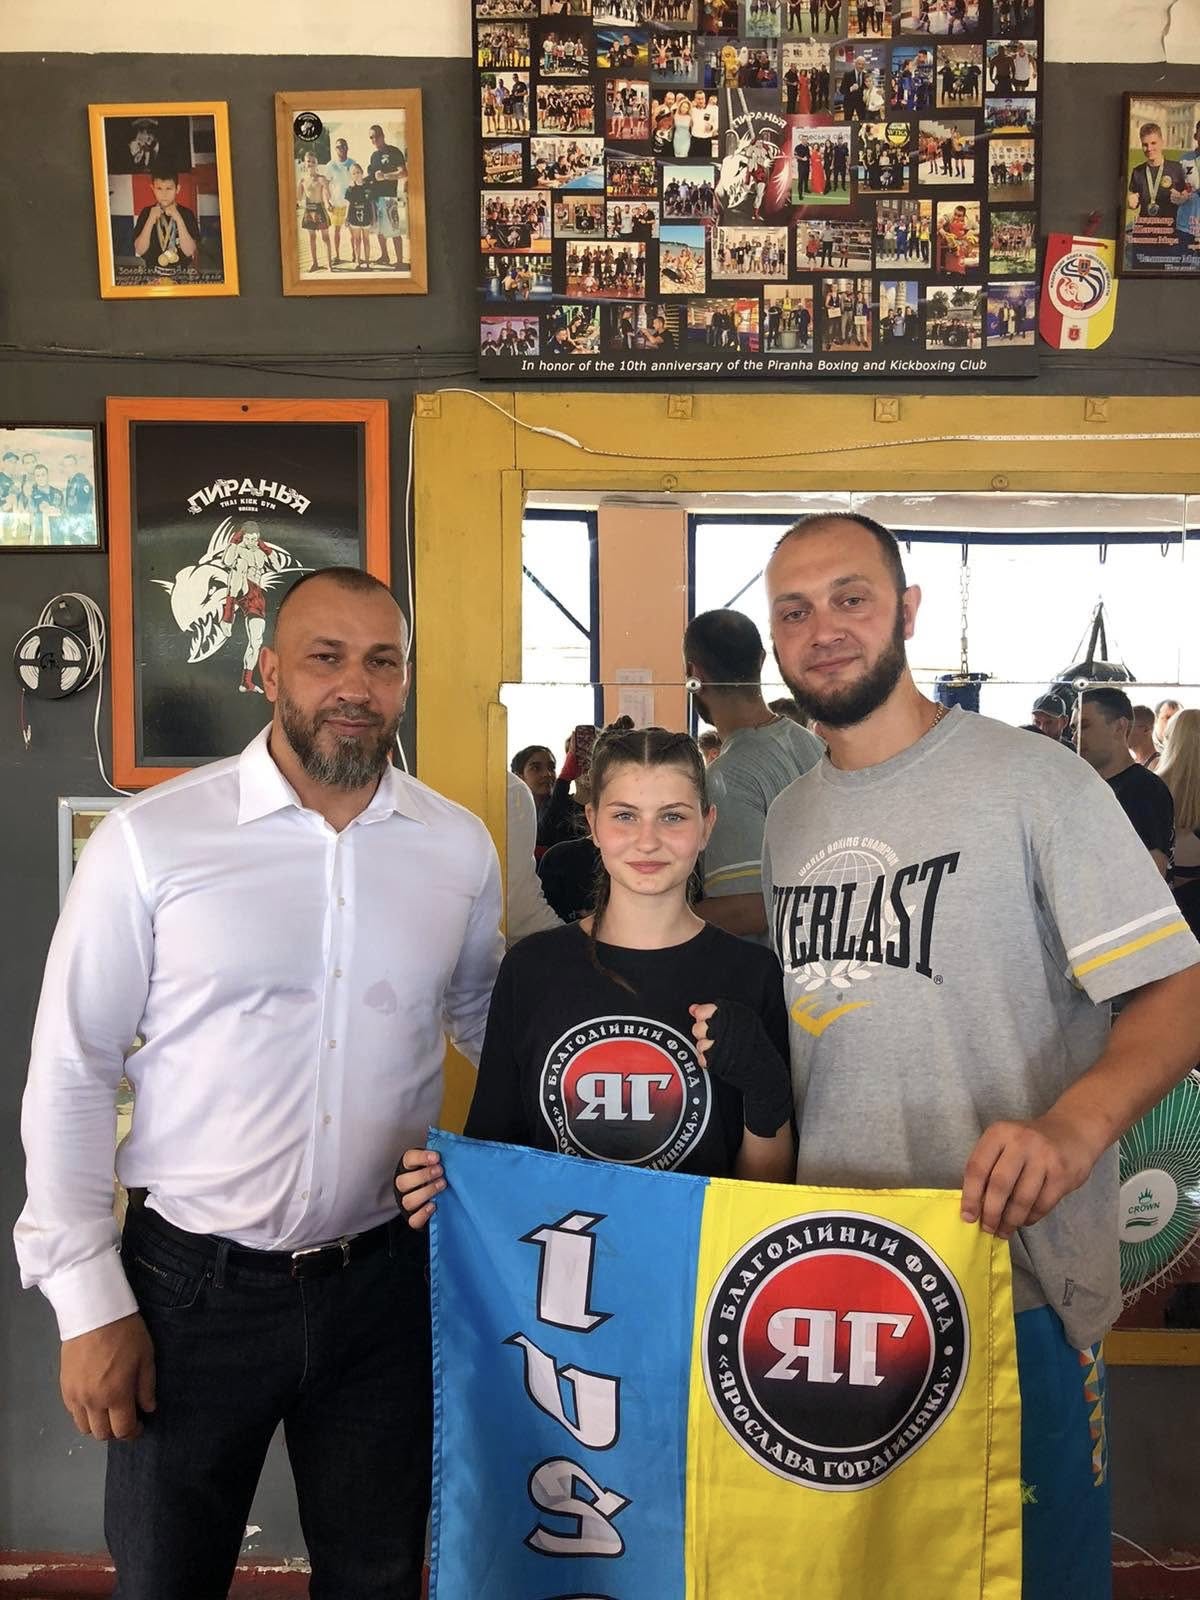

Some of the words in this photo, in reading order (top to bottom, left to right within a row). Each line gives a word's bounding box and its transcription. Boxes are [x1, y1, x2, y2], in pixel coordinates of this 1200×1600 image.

[732, 111, 788, 129] ПИРАНЬЯ
[521, 360, 535, 371] In
[539, 360, 575, 371] honor
[578, 360, 592, 371] of
[595, 360, 615, 371] the
[619, 360, 647, 371] 10th
[651, 360, 723, 372] anniversary
[727, 359, 741, 370] of
[743, 360, 763, 370] the
[768, 360, 813, 370] Piranha
[818, 360, 859, 372] Boxing
[863, 360, 886, 370] and
[890, 360, 955, 372] Kickboxing
[960, 360, 987, 370] Club
[187, 478, 311, 515] ПИРАНЬЯ
[220, 499, 238, 508] THAI
[260, 500, 277, 510] GYM
[798, 849, 826, 877] WORLD
[827, 836, 860, 855] BOXING
[861, 836, 900, 867] CHAMPION
[773, 851, 961, 979] VERLAST
[548, 1023, 664, 1086] БЛАГОДІЙНИЙ
[666, 1039, 701, 1088] ФОНД
[575, 1072, 673, 1122] ЯГ
[1128, 1202, 1161, 1215] CROWN
[720, 1223, 900, 1321] БЛАГОДІЙНИЙ
[904, 1254, 954, 1333] ФОНД
[763, 1307, 914, 1387] ЯГ
